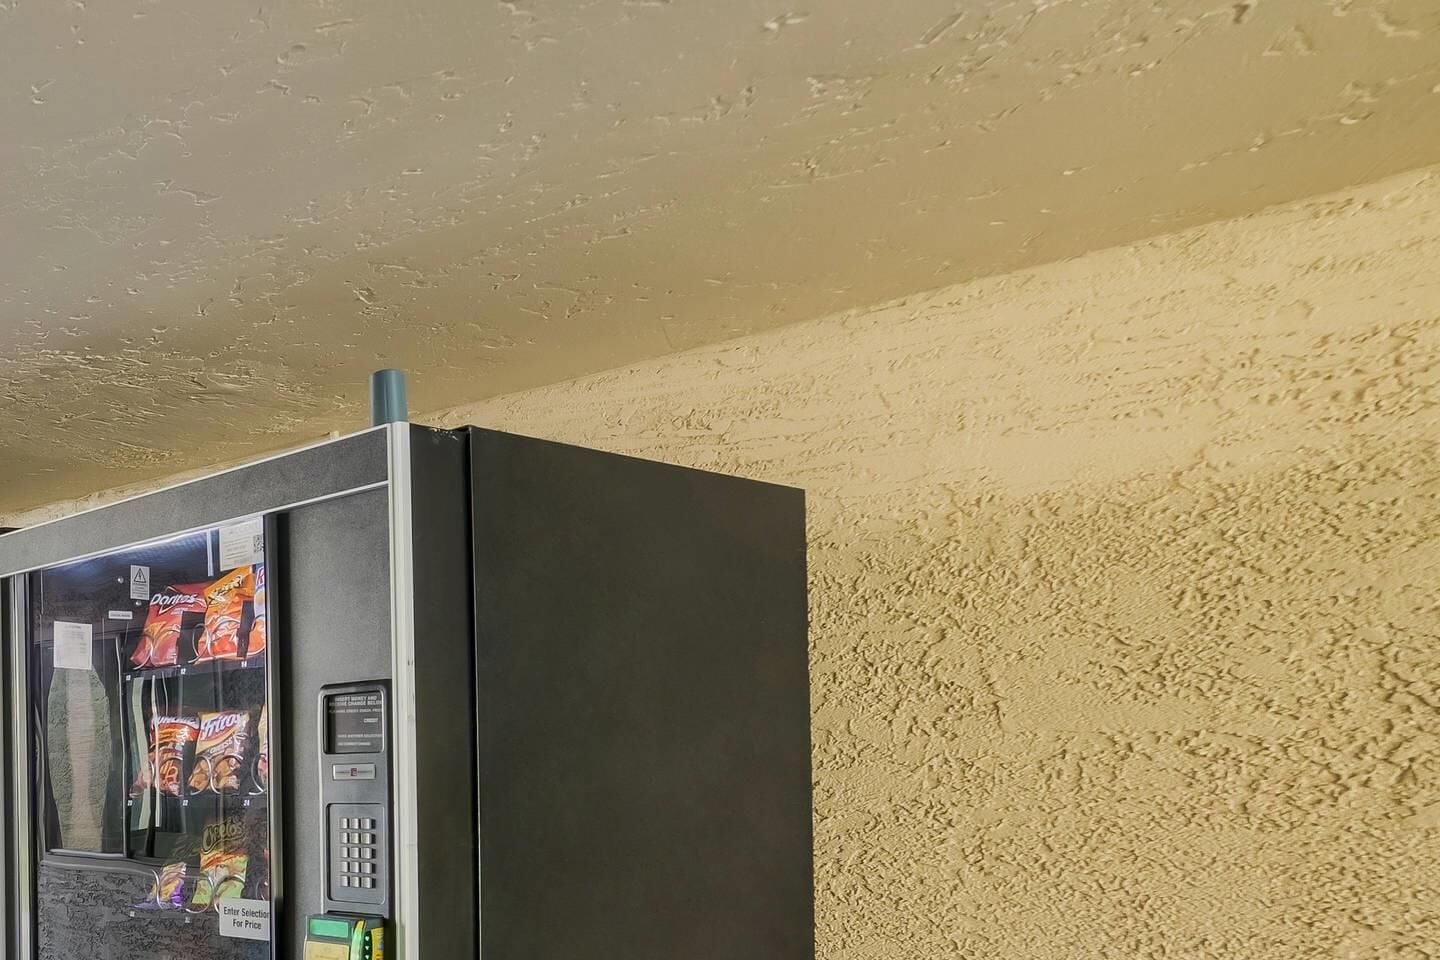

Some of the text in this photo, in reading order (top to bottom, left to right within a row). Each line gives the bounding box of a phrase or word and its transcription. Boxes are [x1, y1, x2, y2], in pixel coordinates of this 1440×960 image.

[150, 593, 198, 606] Doritos
[200, 712, 242, 740] Fritos
[224, 906, 239, 916] Enter
[232, 919, 262, 929] For Price
